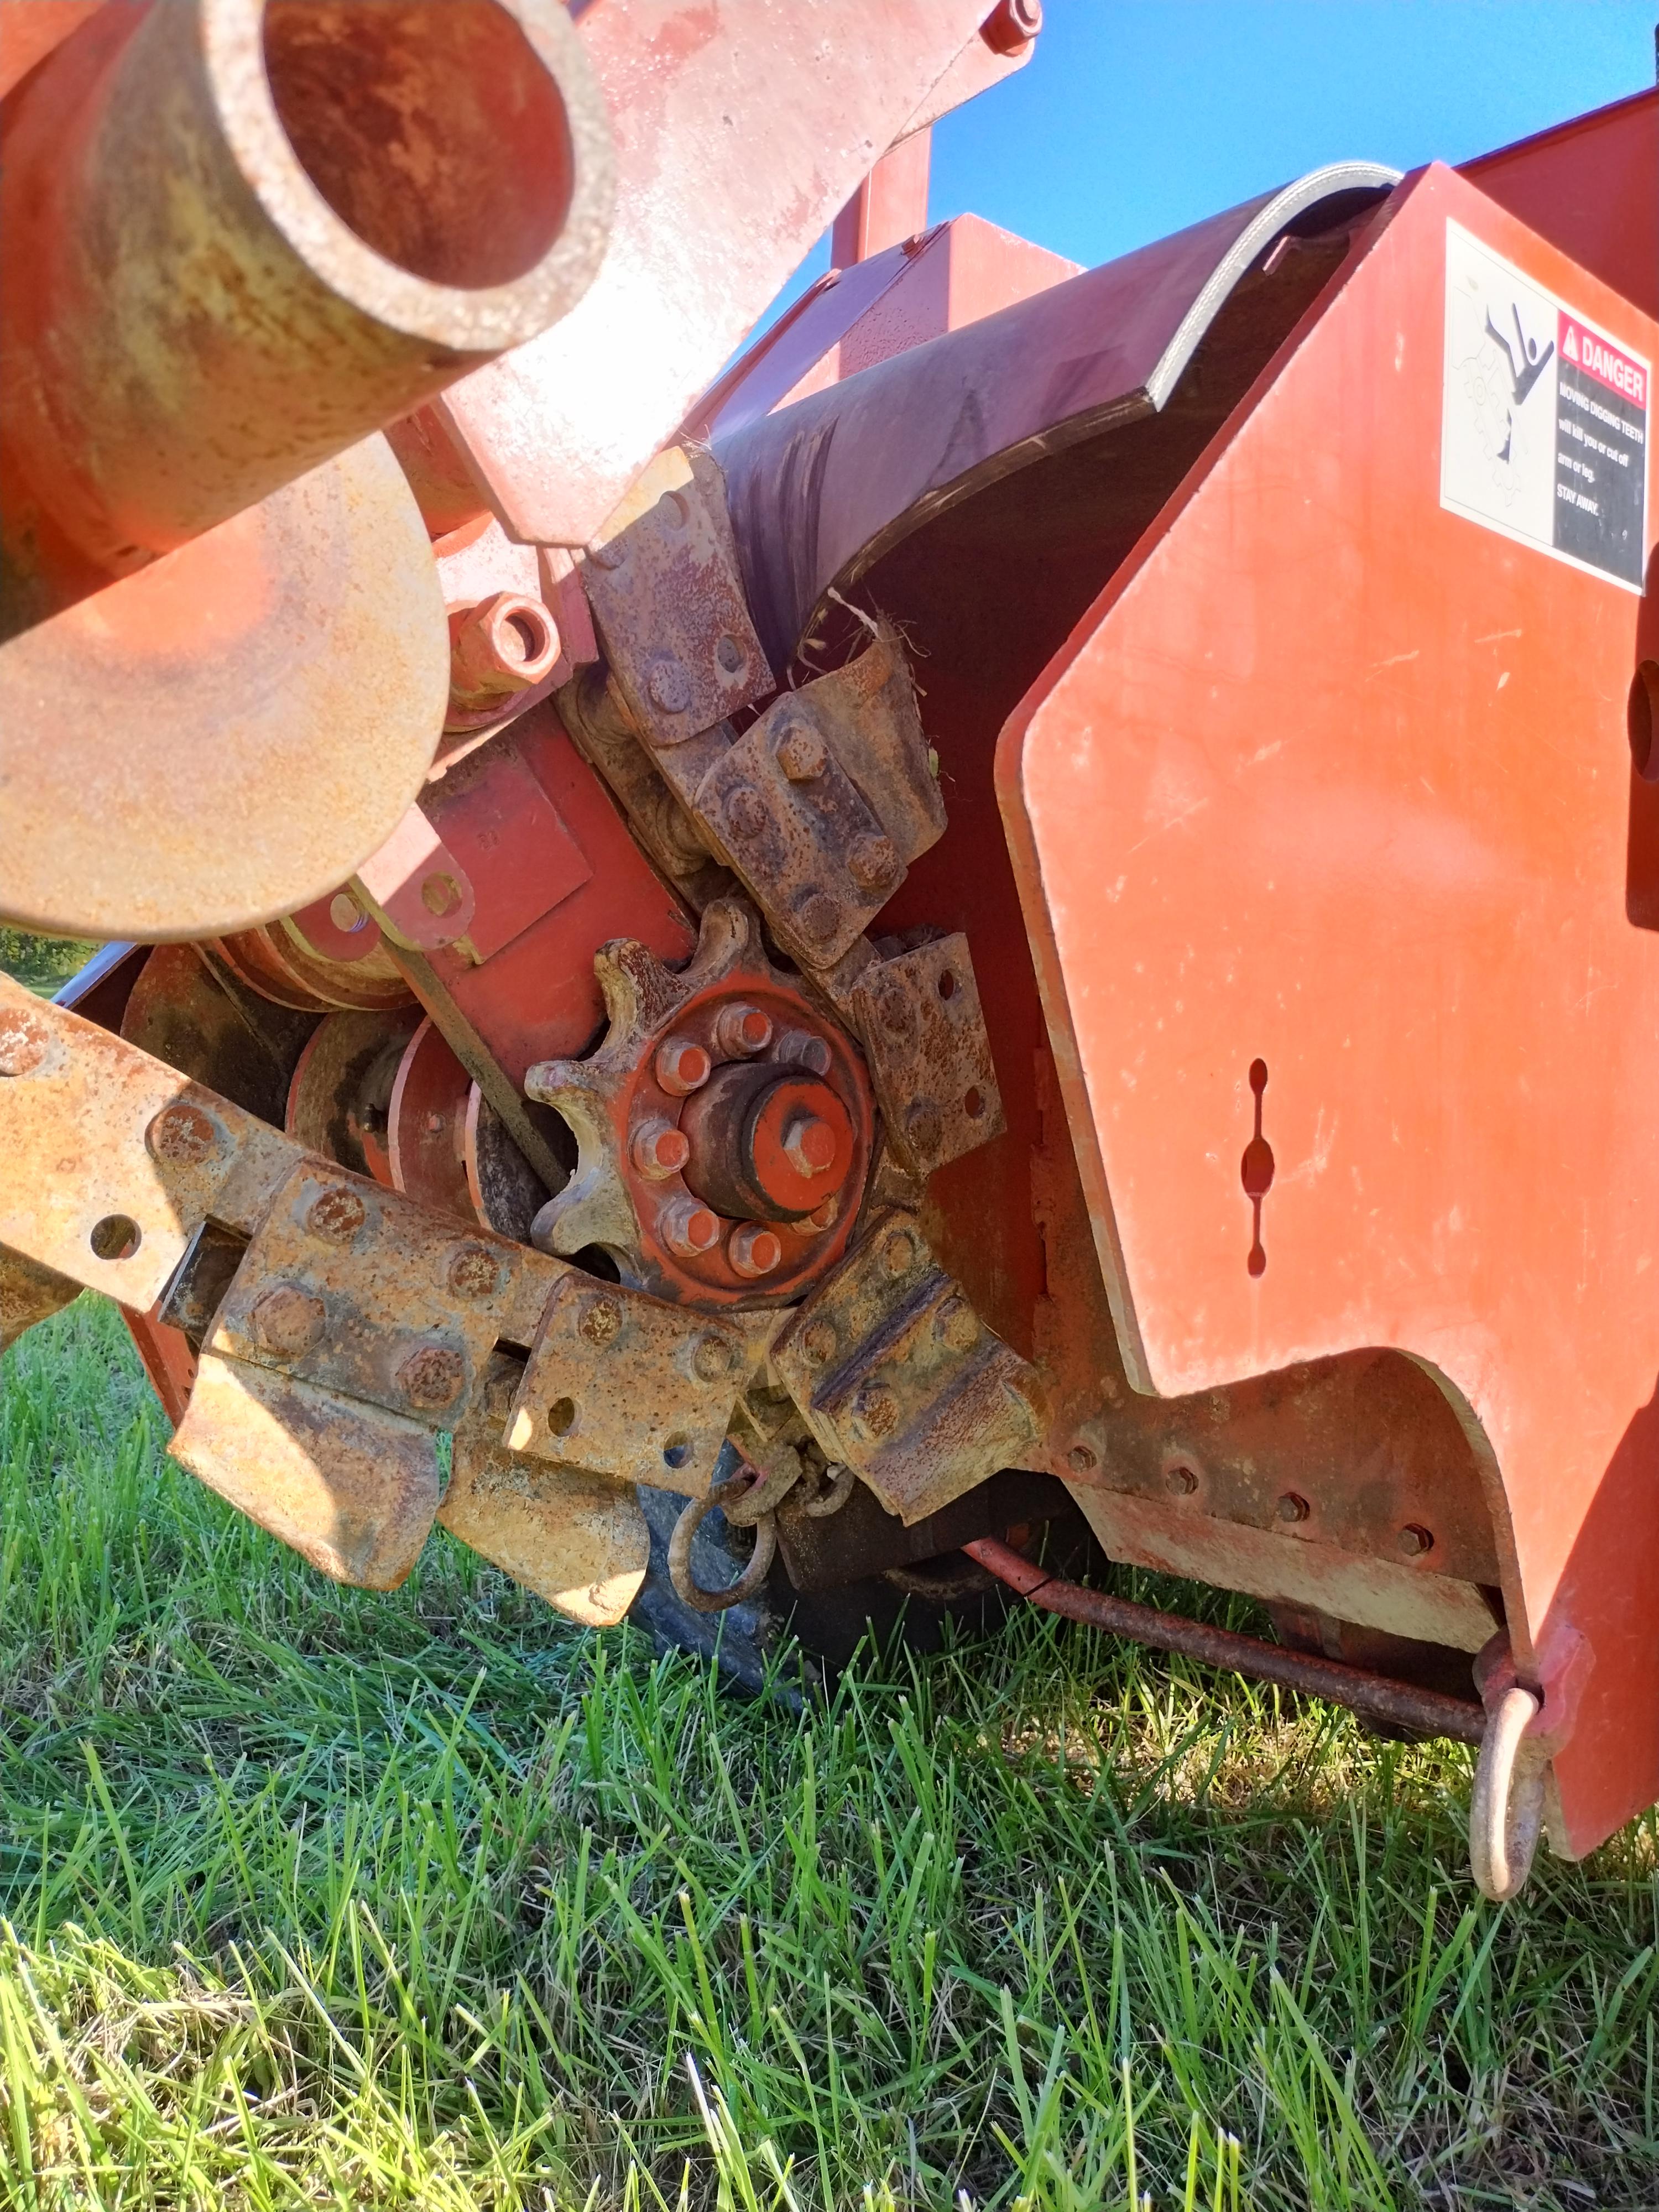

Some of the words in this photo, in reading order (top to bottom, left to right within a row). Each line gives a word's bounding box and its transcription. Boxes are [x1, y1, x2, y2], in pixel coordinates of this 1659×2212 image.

[1583, 336, 1643, 402] DANGER
[1559, 382, 1590, 411] MOVING
[1590, 401, 1621, 431] DIGGING
[1621, 420, 1644, 445] TEETH
[1558, 419, 1572, 435] will
[1572, 424, 1583, 442] kill
[1584, 433, 1598, 450] you
[1598, 443, 1606, 455] or
[1606, 447, 1618, 462] cut
[1618, 453, 1629, 468] off
[1558, 452, 1573, 469] arm
[1573, 461, 1582, 474] or
[1582, 463, 1596, 483] leg.
[1557, 483, 1577, 504] STAY
[1576, 494, 1599, 517] AWAY.
